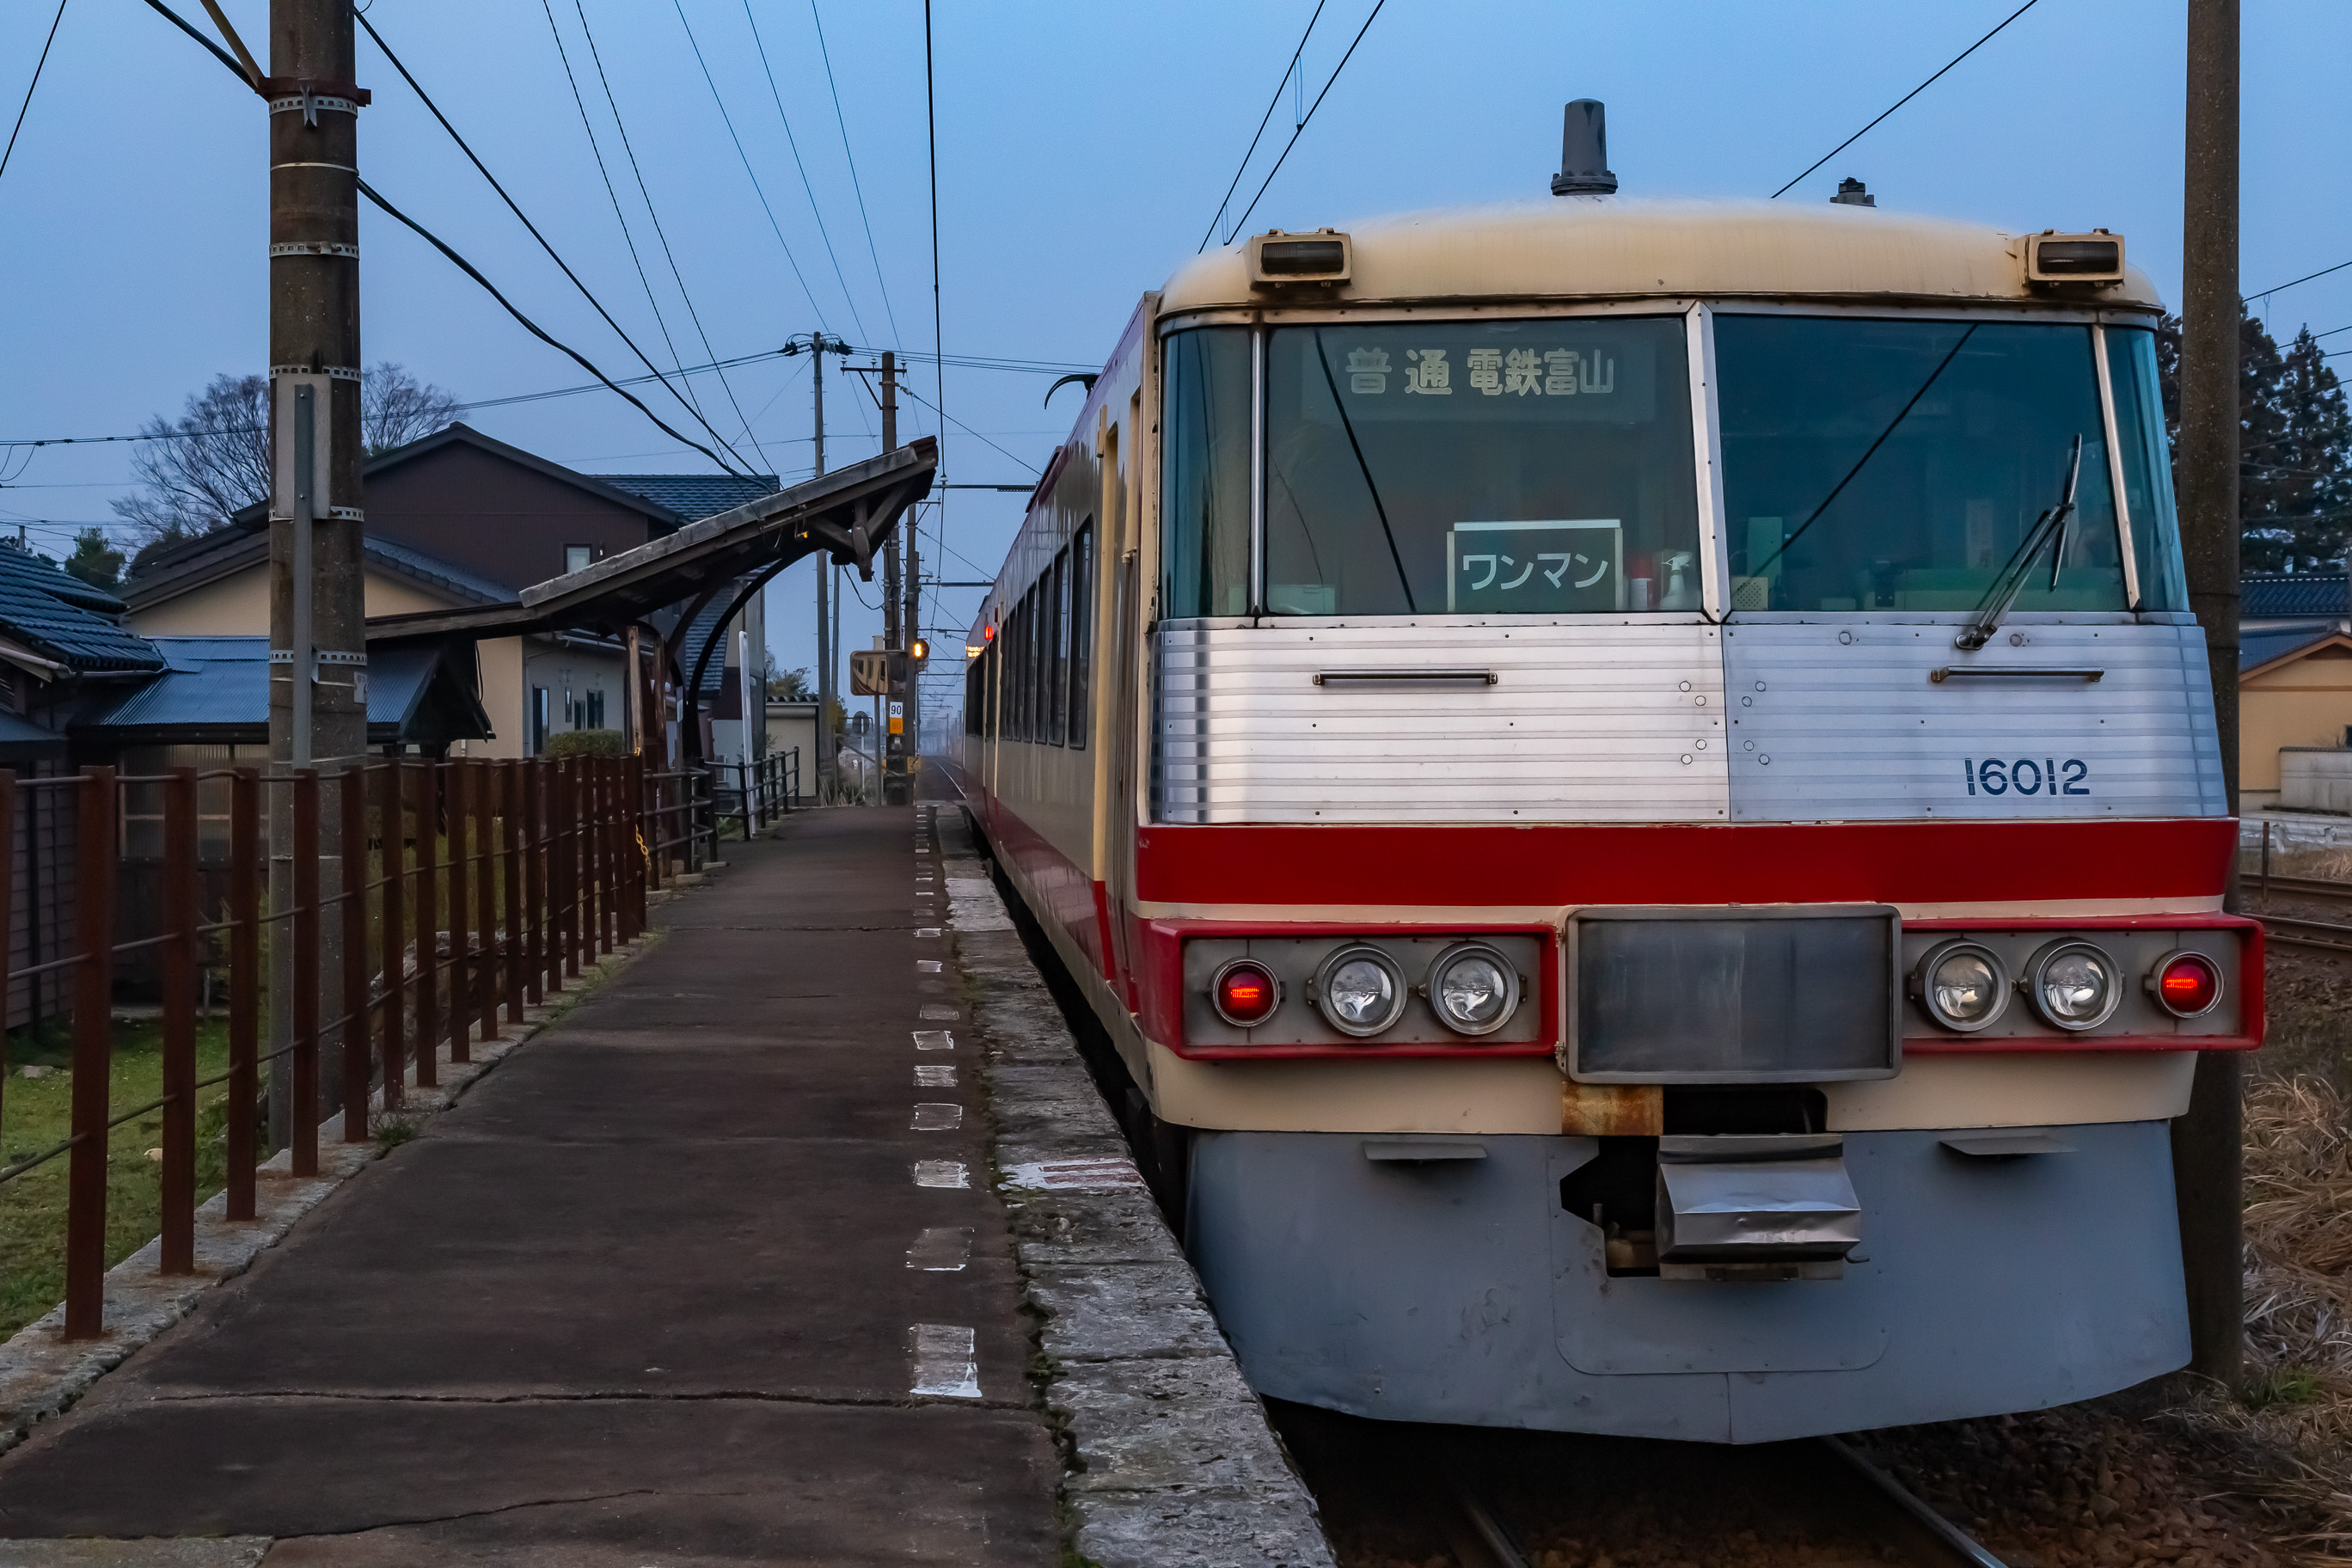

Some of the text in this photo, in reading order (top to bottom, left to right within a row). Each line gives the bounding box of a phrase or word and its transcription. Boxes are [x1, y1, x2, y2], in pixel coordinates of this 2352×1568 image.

[1467, 347, 1614, 396] 電鉄富山
[1462, 553, 1608, 591] ワンマン
[891, 705, 902, 714] 90
[1964, 757, 2090, 796] 16012
